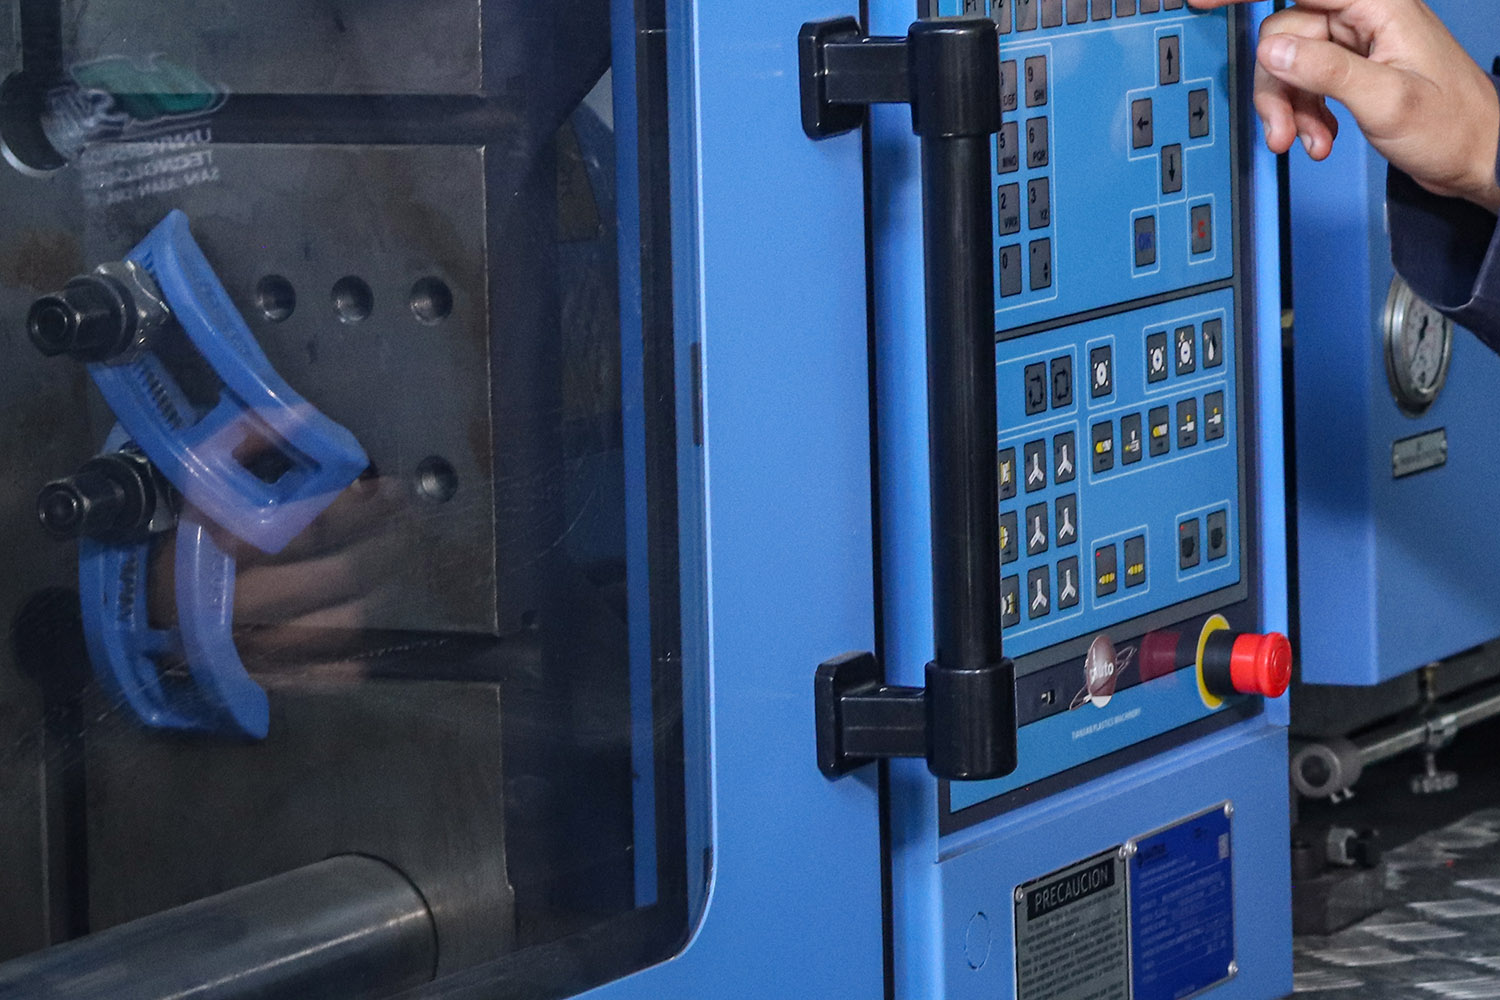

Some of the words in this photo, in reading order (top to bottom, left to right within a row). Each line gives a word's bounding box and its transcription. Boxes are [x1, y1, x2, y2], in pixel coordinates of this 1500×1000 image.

[1027, 66, 1034, 83] 9
[1000, 132, 1006, 149] 5
[1029, 127, 1035, 144] 6
[1000, 192, 1007, 210] 2
[1030, 187, 1037, 204] 3
[1002, 252, 1008, 270] 0
[1034, 864, 1109, 912] PRECAUCION
